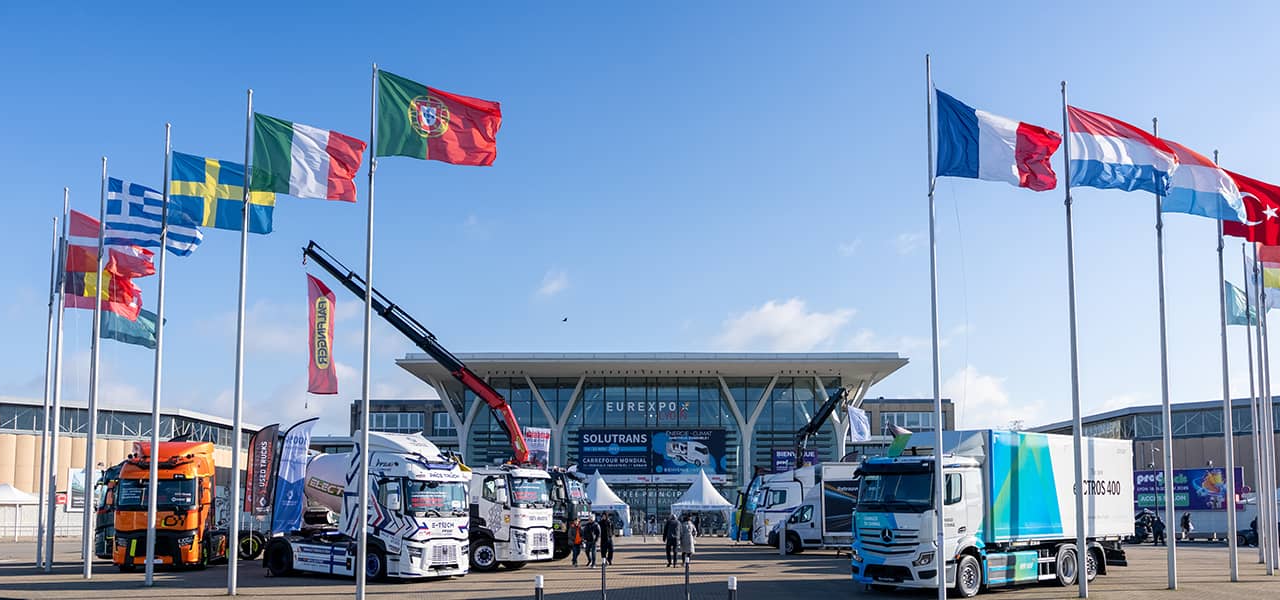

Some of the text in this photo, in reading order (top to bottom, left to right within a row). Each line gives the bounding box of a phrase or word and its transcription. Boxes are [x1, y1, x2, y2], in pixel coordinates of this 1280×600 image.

[606, 402, 677, 412] EUREXPO
[583, 434, 648, 444] SOLUTRANS
[1073, 480, 1121, 495] eCTROS 400
